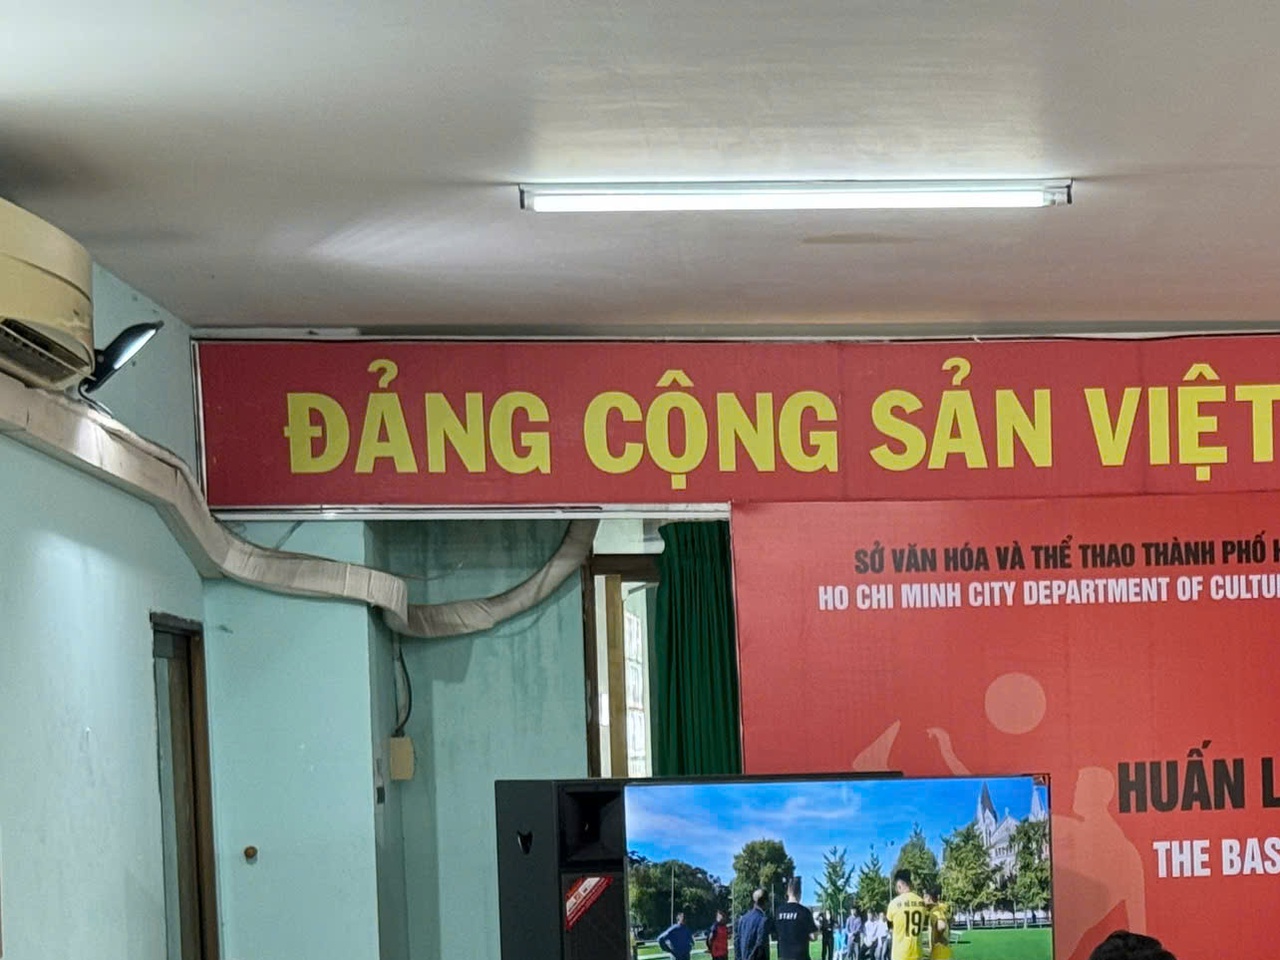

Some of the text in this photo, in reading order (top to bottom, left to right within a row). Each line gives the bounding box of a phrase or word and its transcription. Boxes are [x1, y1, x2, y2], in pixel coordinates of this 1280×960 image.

[284, 358, 551, 474] ĐẢNG
[584, 369, 839, 490] CỘNG
[869, 357, 1052, 471] SẢN
[854, 541, 885, 574] SỞ
[891, 543, 938, 573] VĂN
[944, 541, 990, 572] HÓA
[995, 540, 1026, 571] VÀ
[1031, 535, 1073, 570] THỂ
[1078, 542, 1136, 569] THAO
[1141, 537, 1215, 567] THÀNH
[1222, 530, 1267, 564] PHỐ
[817, 585, 849, 611] HO
[856, 583, 894, 610] CHI
[901, 582, 962, 609] MINH
[968, 580, 1017, 607] CITY
[1023, 577, 1171, 606] DEPARTMENT
[1176, 575, 1205, 602] OF
[1117, 740, 1247, 813] HUẤN
[1153, 839, 1211, 878] THE
[778, 912, 798, 920] STAFF
[904, 910, 922, 937] 19
